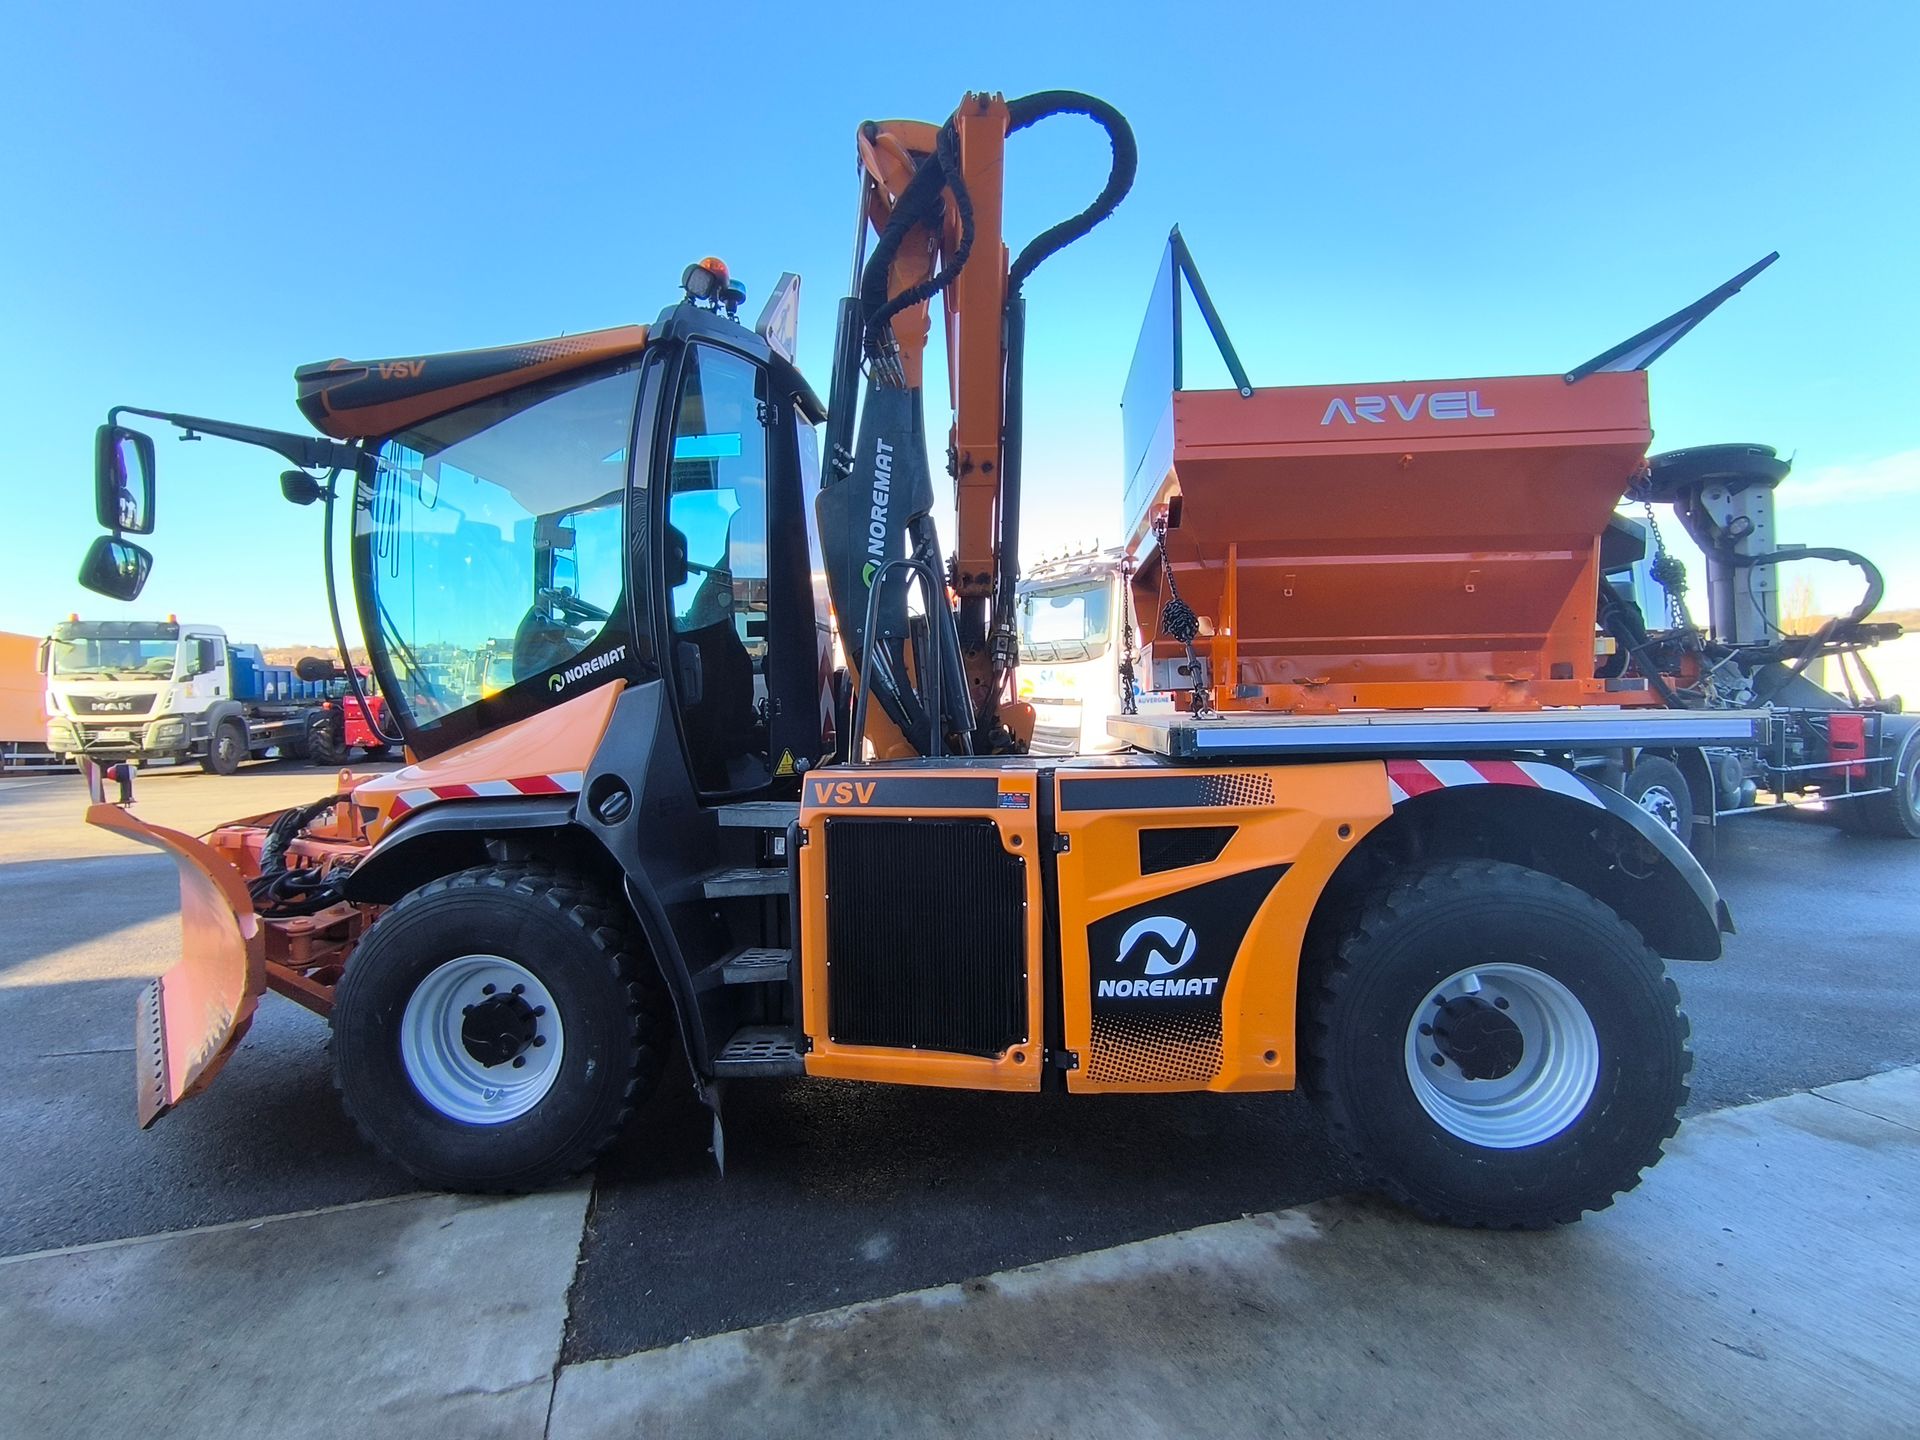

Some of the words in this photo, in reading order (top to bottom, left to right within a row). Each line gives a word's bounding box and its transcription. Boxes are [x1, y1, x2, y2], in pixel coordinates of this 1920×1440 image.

[379, 360, 426, 379] VSV
[1320, 391, 1495, 425] ARVEL
[868, 438, 893, 556] NOREMAT
[564, 645, 626, 684] NOREMAT
[91, 702, 132, 711] MAN
[815, 782, 876, 804] VSV
[1098, 977, 1218, 997] NOREMAT
